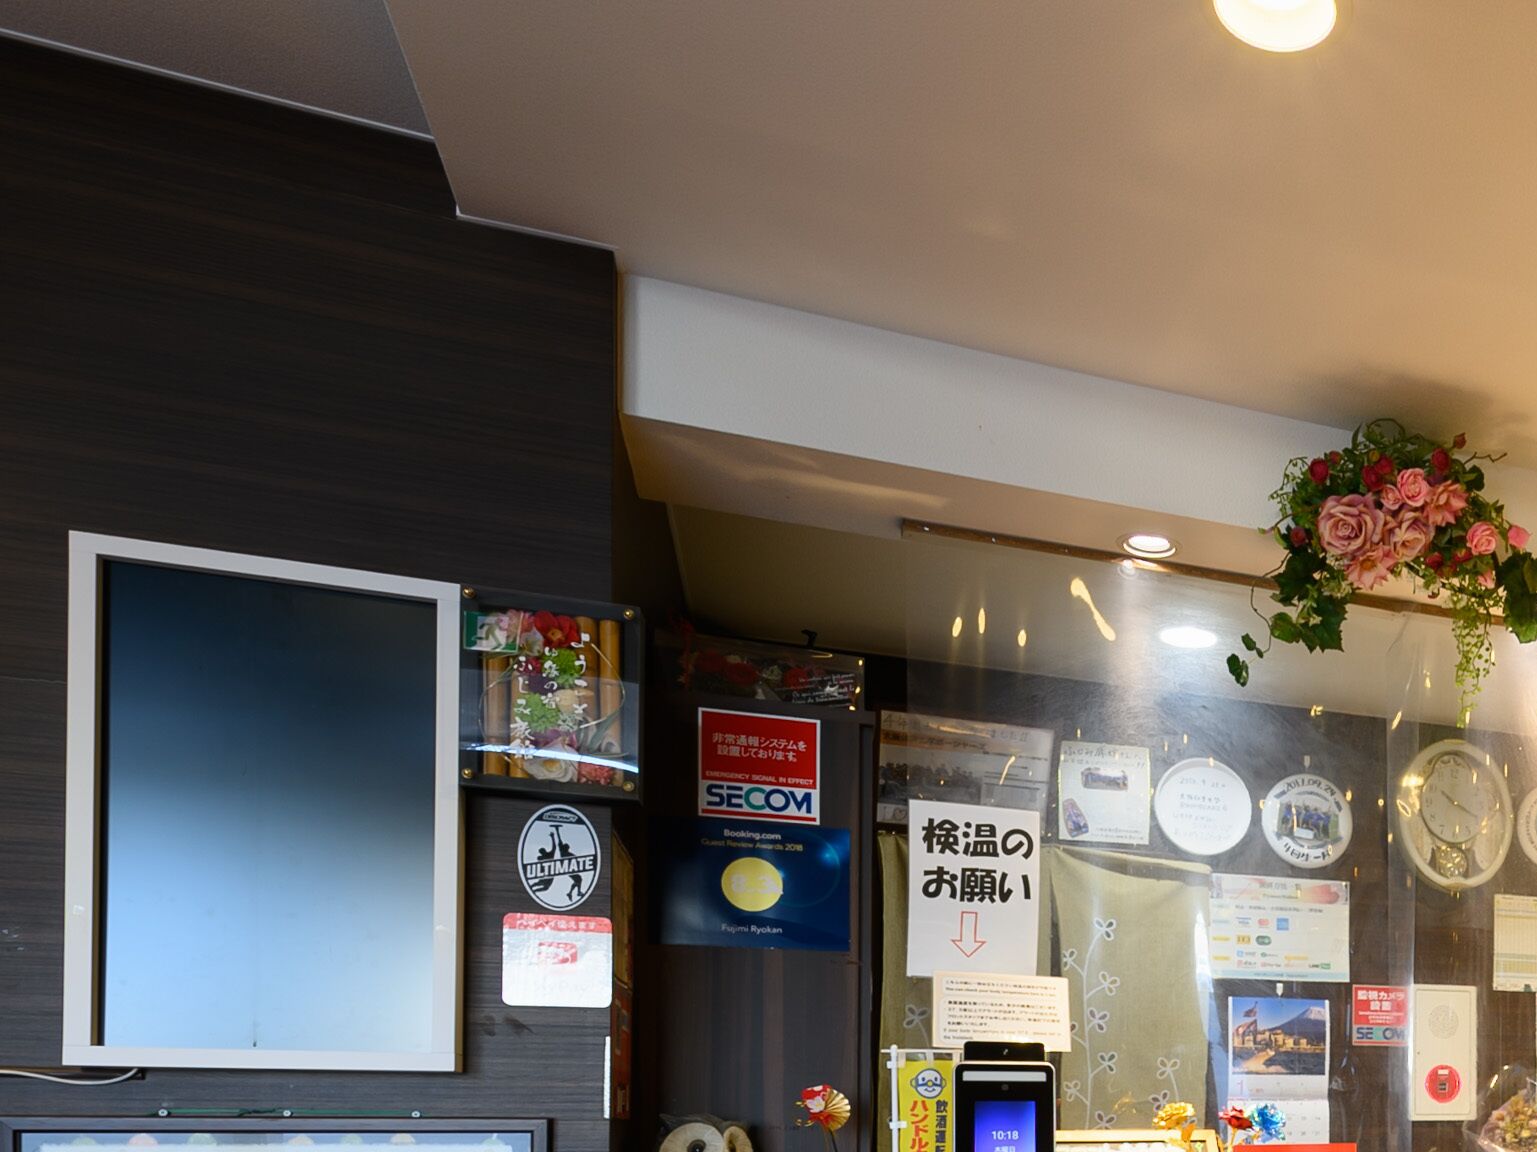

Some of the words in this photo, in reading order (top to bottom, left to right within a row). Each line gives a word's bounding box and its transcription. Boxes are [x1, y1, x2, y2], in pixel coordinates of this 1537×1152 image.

[712, 732, 808, 752] 非常通報システムを
[717, 744, 798, 762] 設置しております。
[706, 770, 750, 781] EMERGENCY
[752, 773, 777, 784] SIGNAL
[778, 776, 786, 784] IN
[787, 777, 814, 786] EFFECT
[705, 783, 813, 815] SECOM
[723, 828, 782, 841] Booking.com
[922, 817, 1034, 860] 検温の
[526, 856, 595, 879] ULTIMATE
[921, 866, 1032, 904] お願い
[721, 923, 749, 935] Fujimi
[750, 925, 783, 936] Ryokan
[1356, 1027, 1405, 1041] SECOM
[991, 1130, 1020, 1141] 10:18
